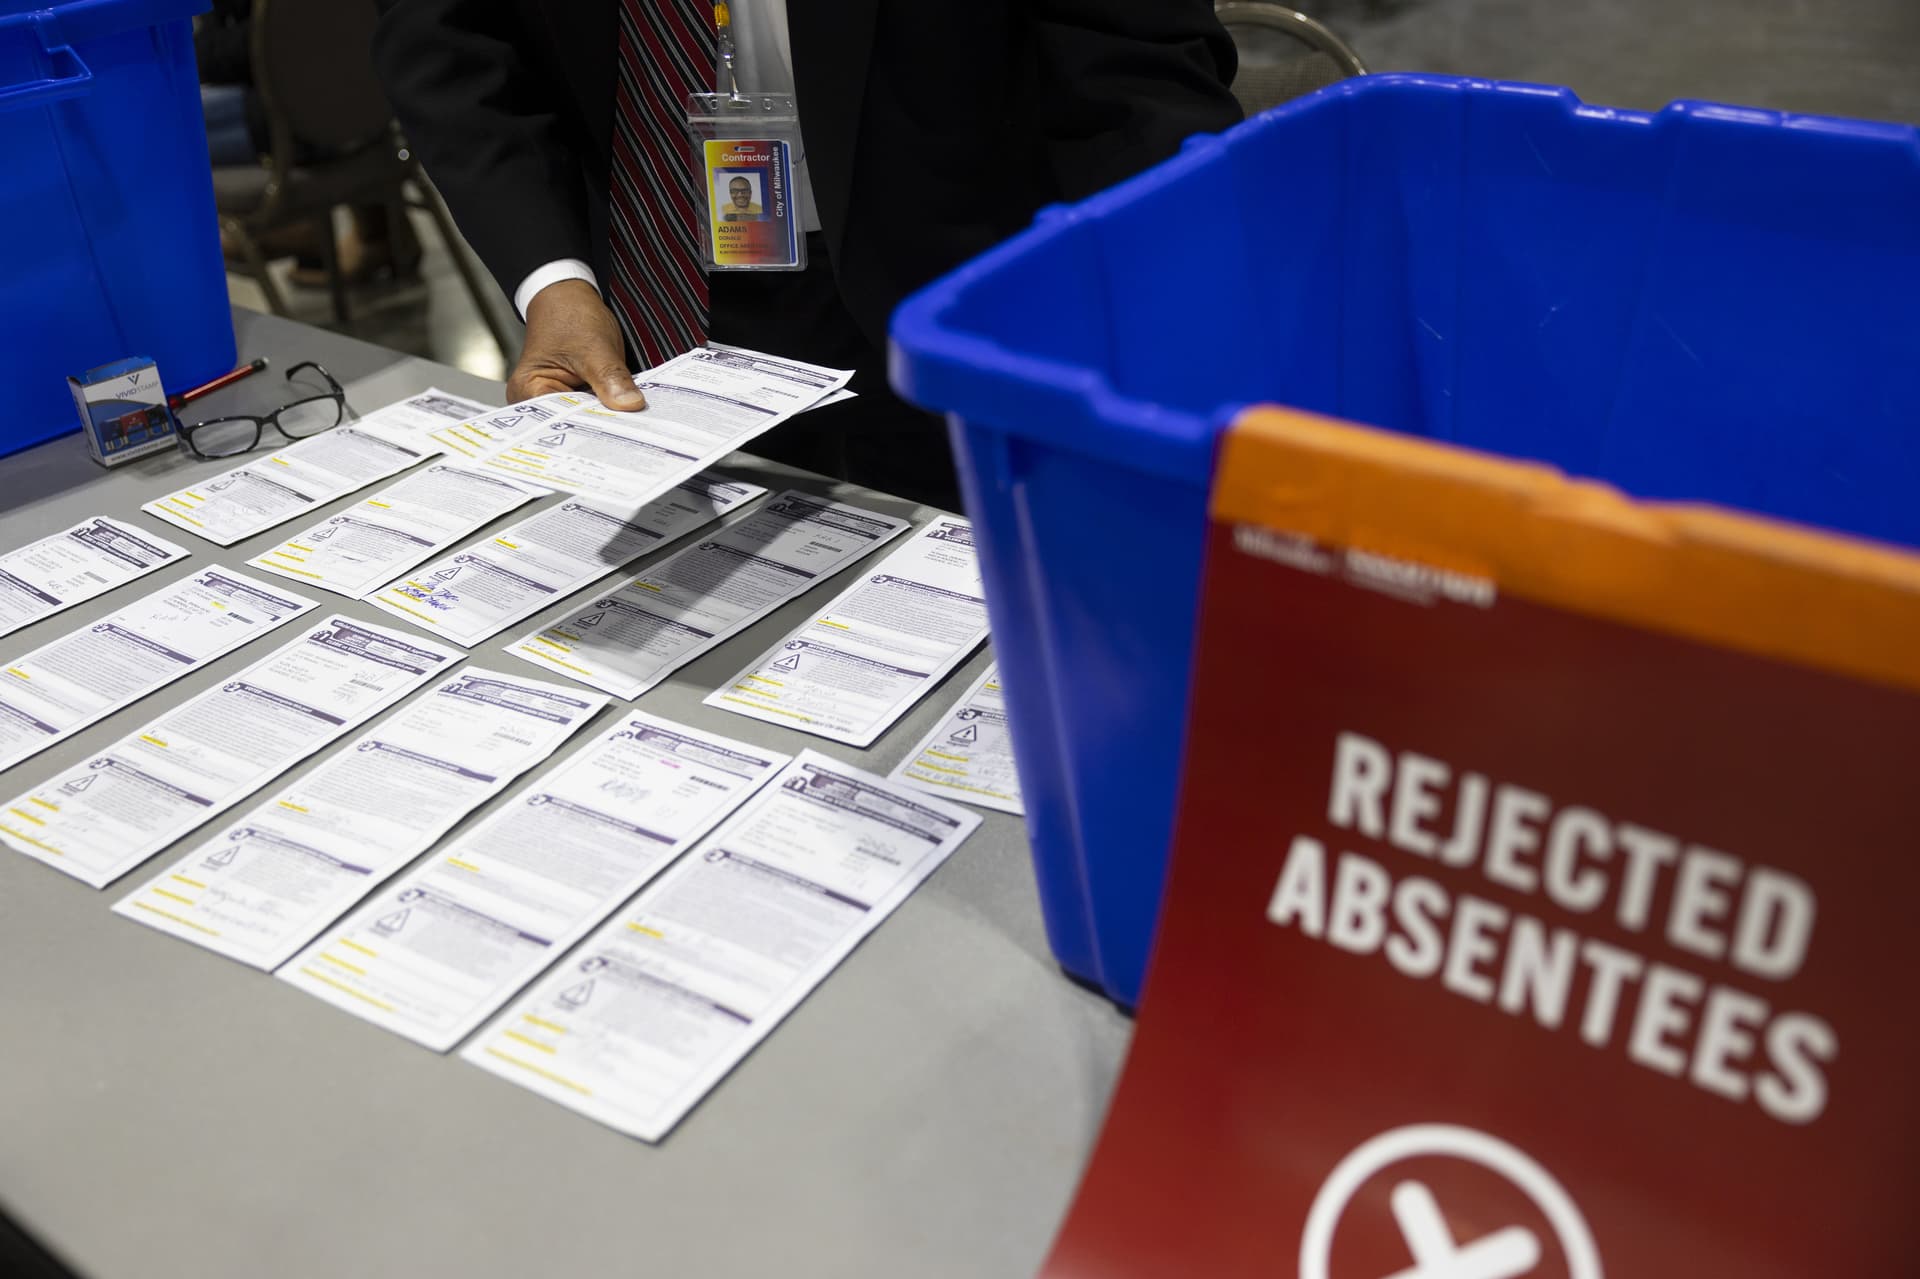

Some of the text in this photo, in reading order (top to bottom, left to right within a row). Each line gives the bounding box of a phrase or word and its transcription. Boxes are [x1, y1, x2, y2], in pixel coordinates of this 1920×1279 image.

[722, 154, 770, 162] Contractor
[772, 146, 785, 217] City of Milwaukee
[1327, 731, 1816, 981] REJECTED
[1266, 835, 1838, 1124] ABSENTEES
